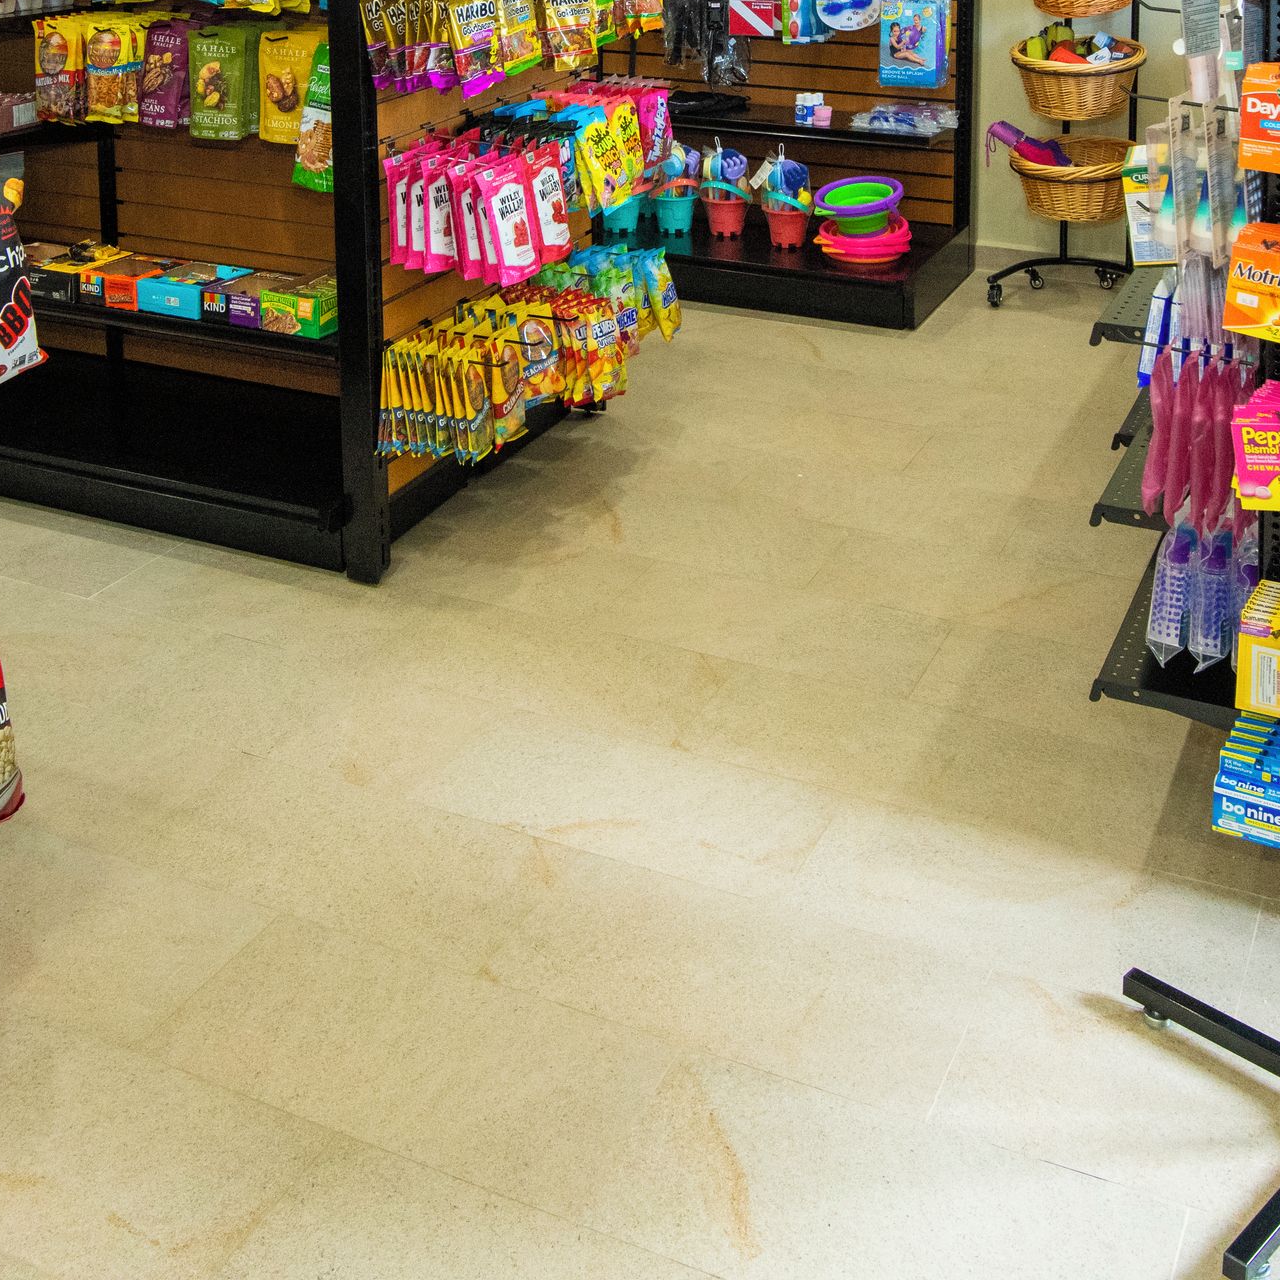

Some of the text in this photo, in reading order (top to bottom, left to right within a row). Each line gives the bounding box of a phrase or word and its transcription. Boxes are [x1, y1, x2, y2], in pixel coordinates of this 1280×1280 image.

[456, 0, 496, 25] HARIBO
[556, 6, 590, 18] Goldbears
[196, 44, 237, 54] SAHALE
[266, 47, 307, 57] SAHALE
[58, 74, 70, 84] MIX
[594, 134, 614, 158] SOUR
[540, 173, 555, 186] WILEY
[540, 180, 561, 201] WALLABY
[499, 189, 520, 205] WILEY
[81, 282, 100, 293] KIND
[204, 302, 225, 312] KIND
[523, 363, 543, 379] PEACH
[1244, 444, 1280, 455] Bismol
